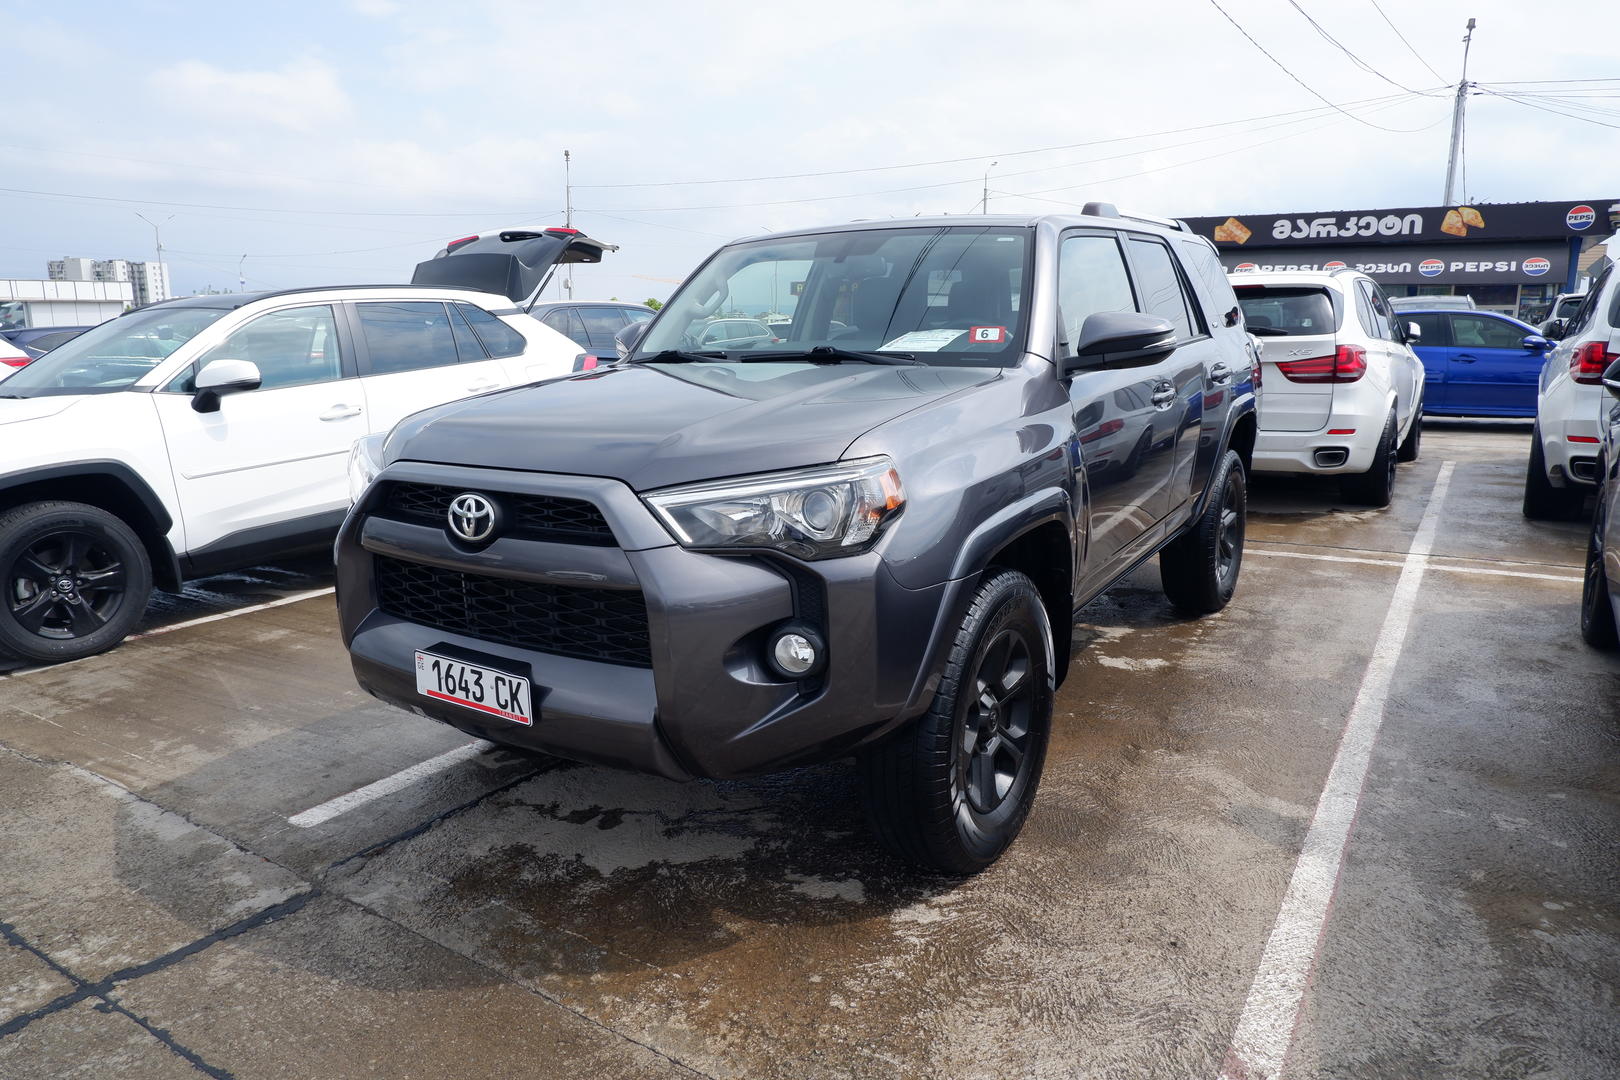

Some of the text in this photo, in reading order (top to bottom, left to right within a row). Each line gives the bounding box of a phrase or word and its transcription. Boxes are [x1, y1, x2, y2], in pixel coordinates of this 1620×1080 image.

[1272, 214, 1423, 239] მარკეტი
[1449, 261, 1517, 272] PEPSI
[980, 329, 989, 339] 6
[1288, 348, 1314, 356] X5
[431, 659, 525, 716] 1643 CK
